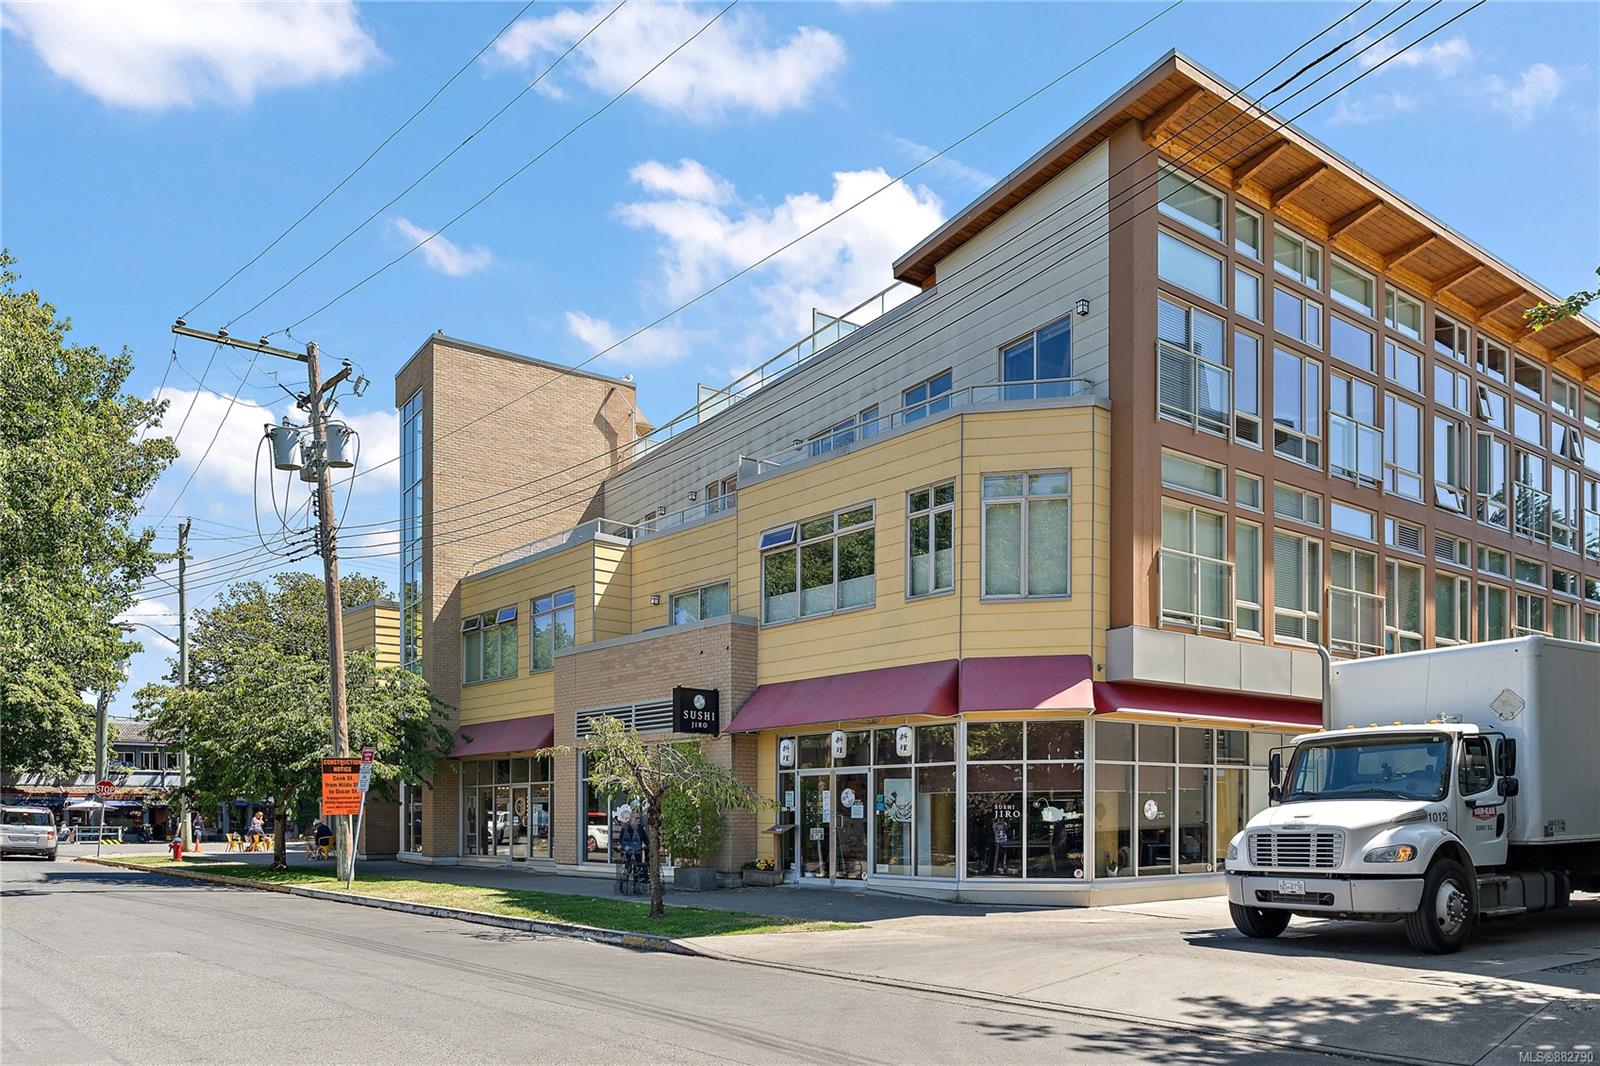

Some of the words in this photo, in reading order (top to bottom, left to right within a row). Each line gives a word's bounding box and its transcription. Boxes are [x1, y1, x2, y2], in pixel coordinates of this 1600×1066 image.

[683, 710, 715, 721] SUSHI
[691, 721, 708, 729] JIRO
[96, 785, 115, 793] STOP
[994, 810, 1020, 819] JIRO
[1428, 812, 1447, 822] 1012
